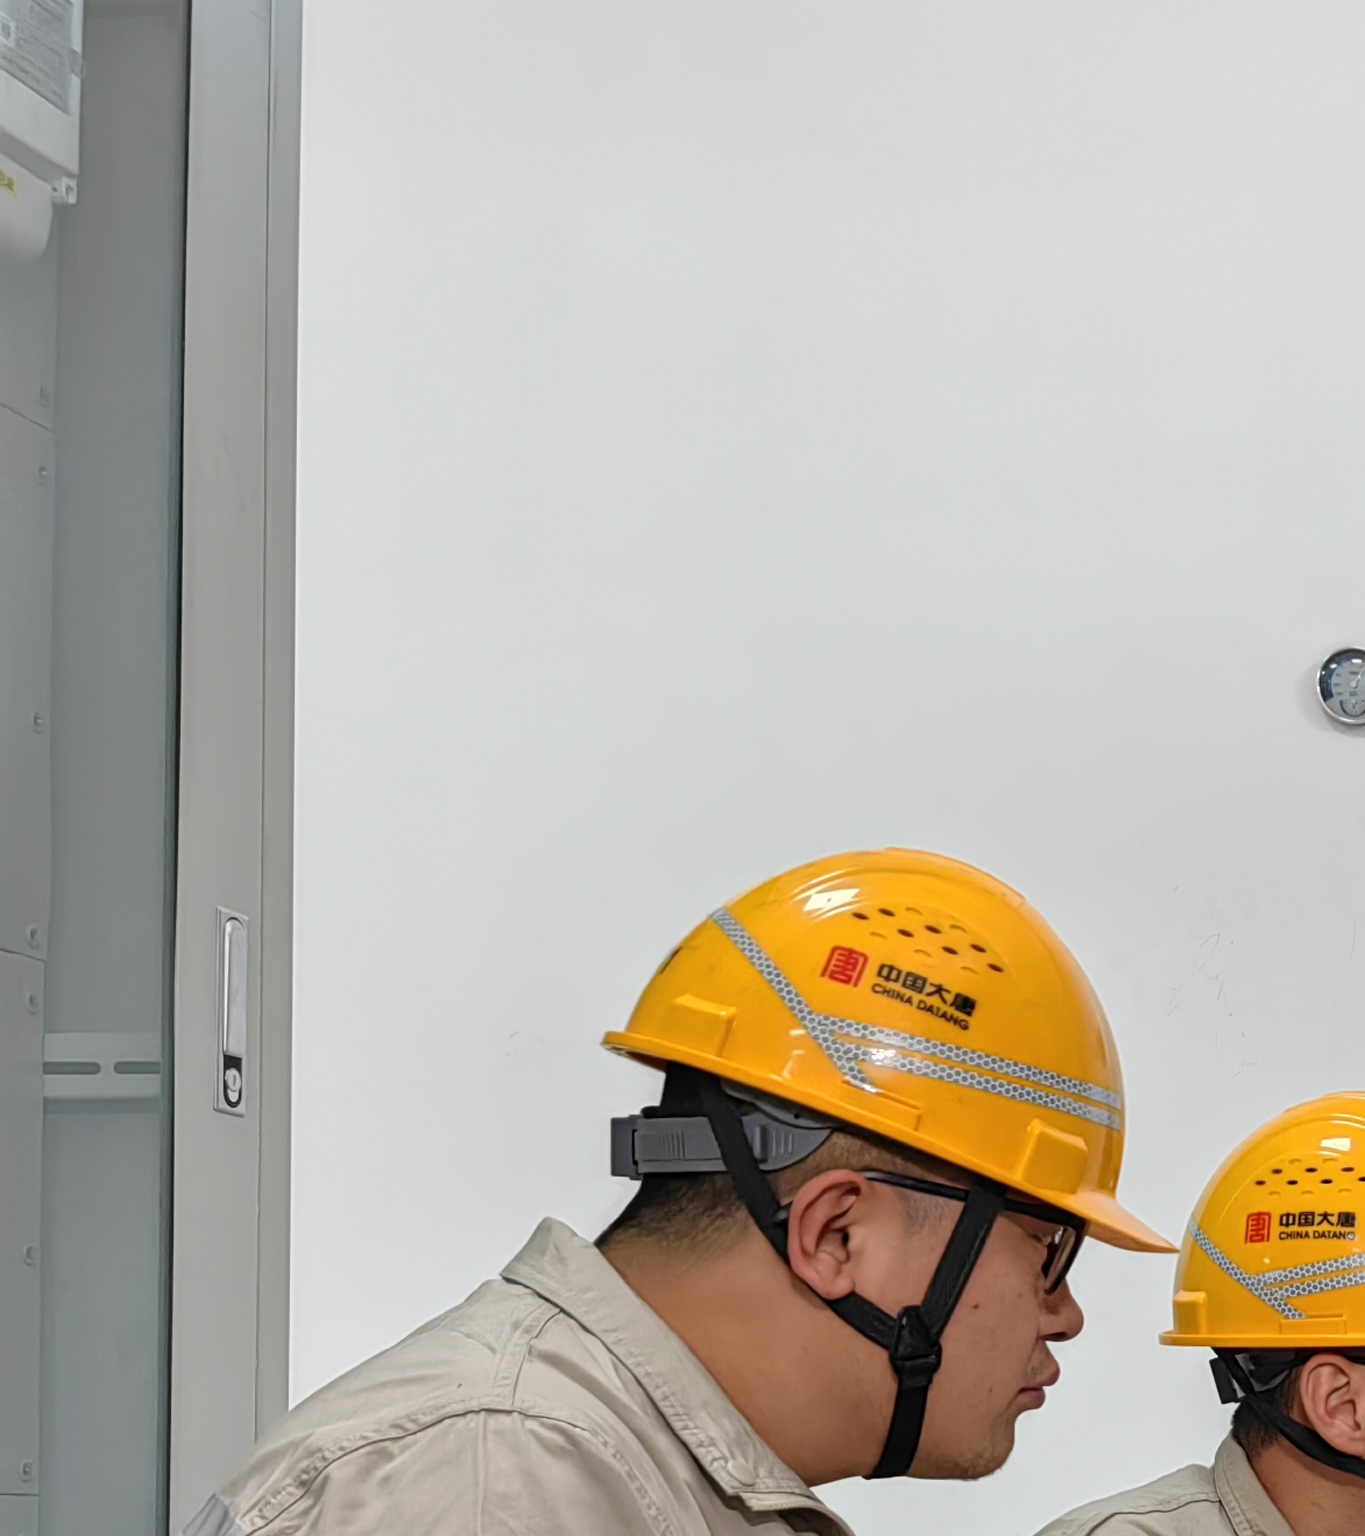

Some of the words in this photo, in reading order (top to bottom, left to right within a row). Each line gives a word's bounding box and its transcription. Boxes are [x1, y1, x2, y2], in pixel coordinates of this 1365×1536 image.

[877, 963, 977, 1017] 中国大唐
[872, 983, 914, 1007] CHINA
[916, 999, 970, 1031] DATANG
[1278, 1230, 1310, 1240] CHINA
[1312, 1230, 1356, 1240] DATANG
[1279, 1211, 1356, 1228] 中国大唐
